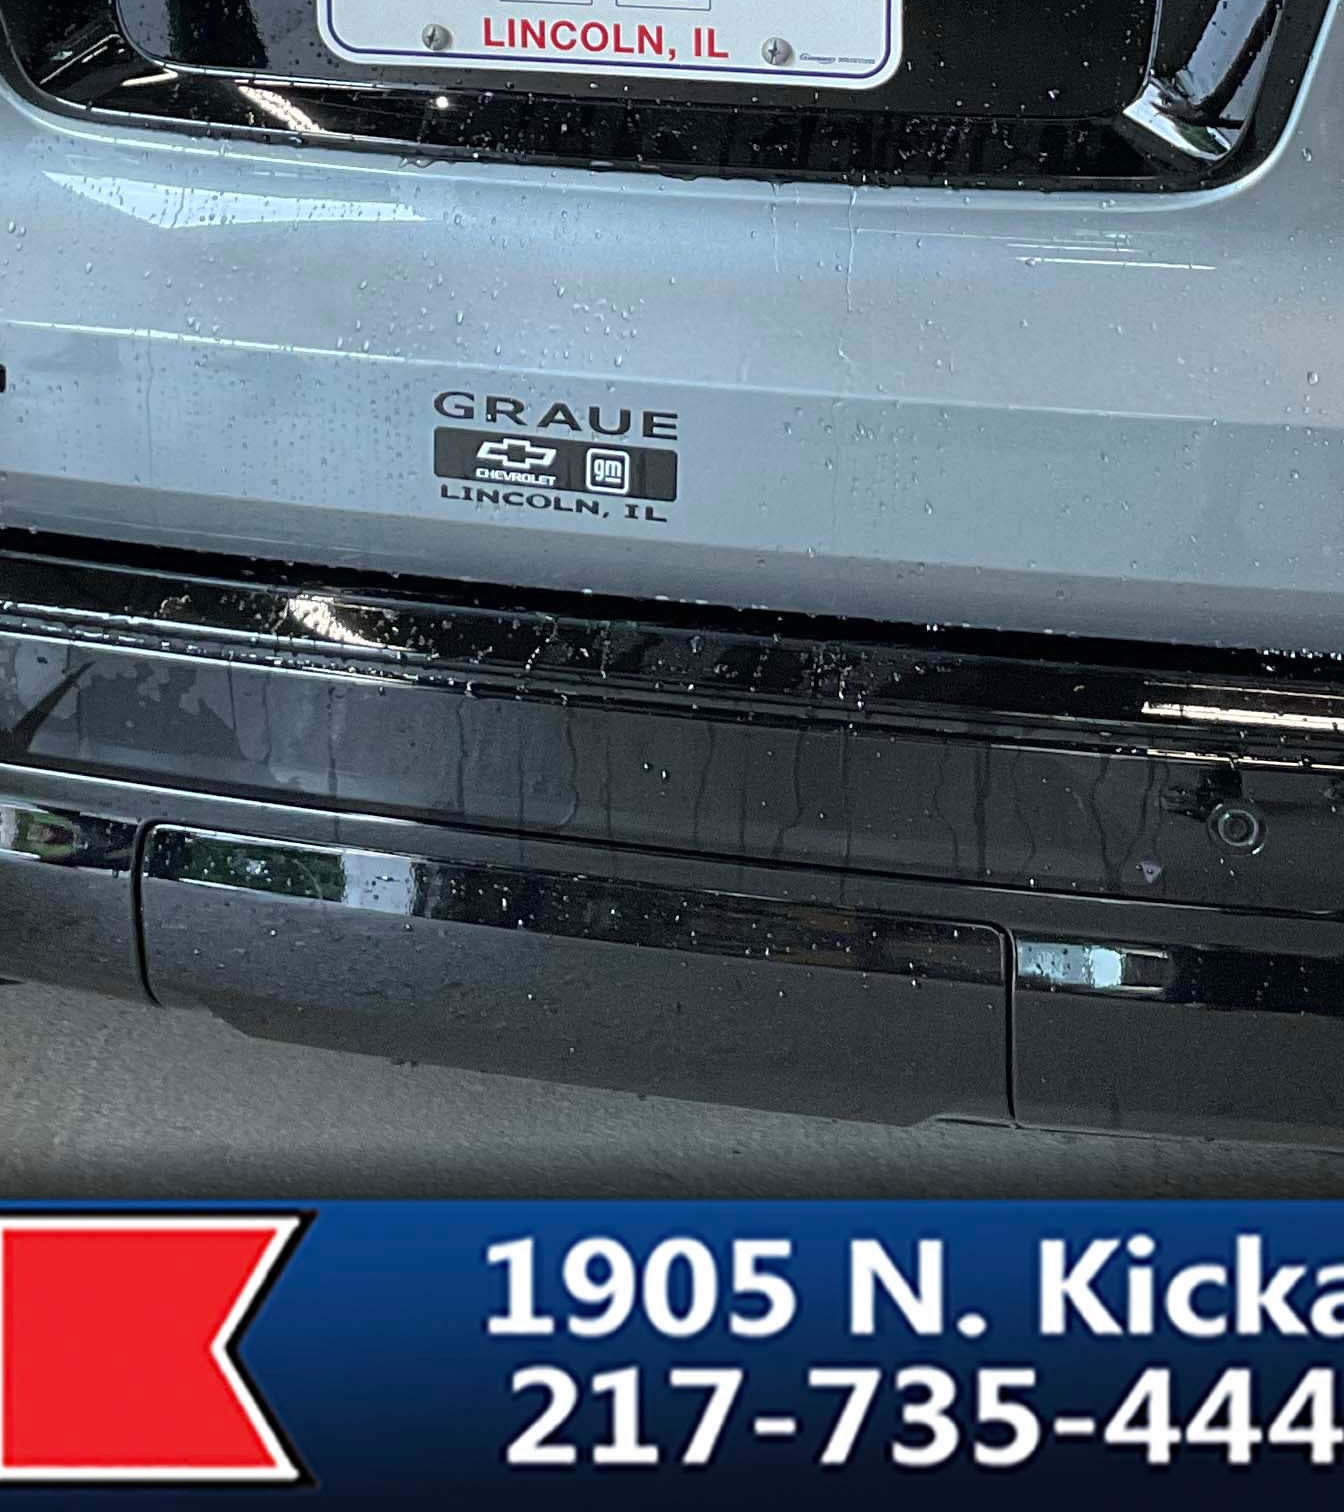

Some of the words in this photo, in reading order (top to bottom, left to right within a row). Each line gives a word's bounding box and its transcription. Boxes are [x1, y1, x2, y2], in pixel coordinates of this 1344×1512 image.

[482, 17, 677, 63] LINCOLN,
[692, 27, 730, 60] IL
[433, 390, 679, 441] GRAUE
[475, 467, 557, 487] CHEVROLET
[593, 457, 623, 484] gm
[440, 483, 610, 519] LINCOLN,
[623, 502, 669, 523] IL
